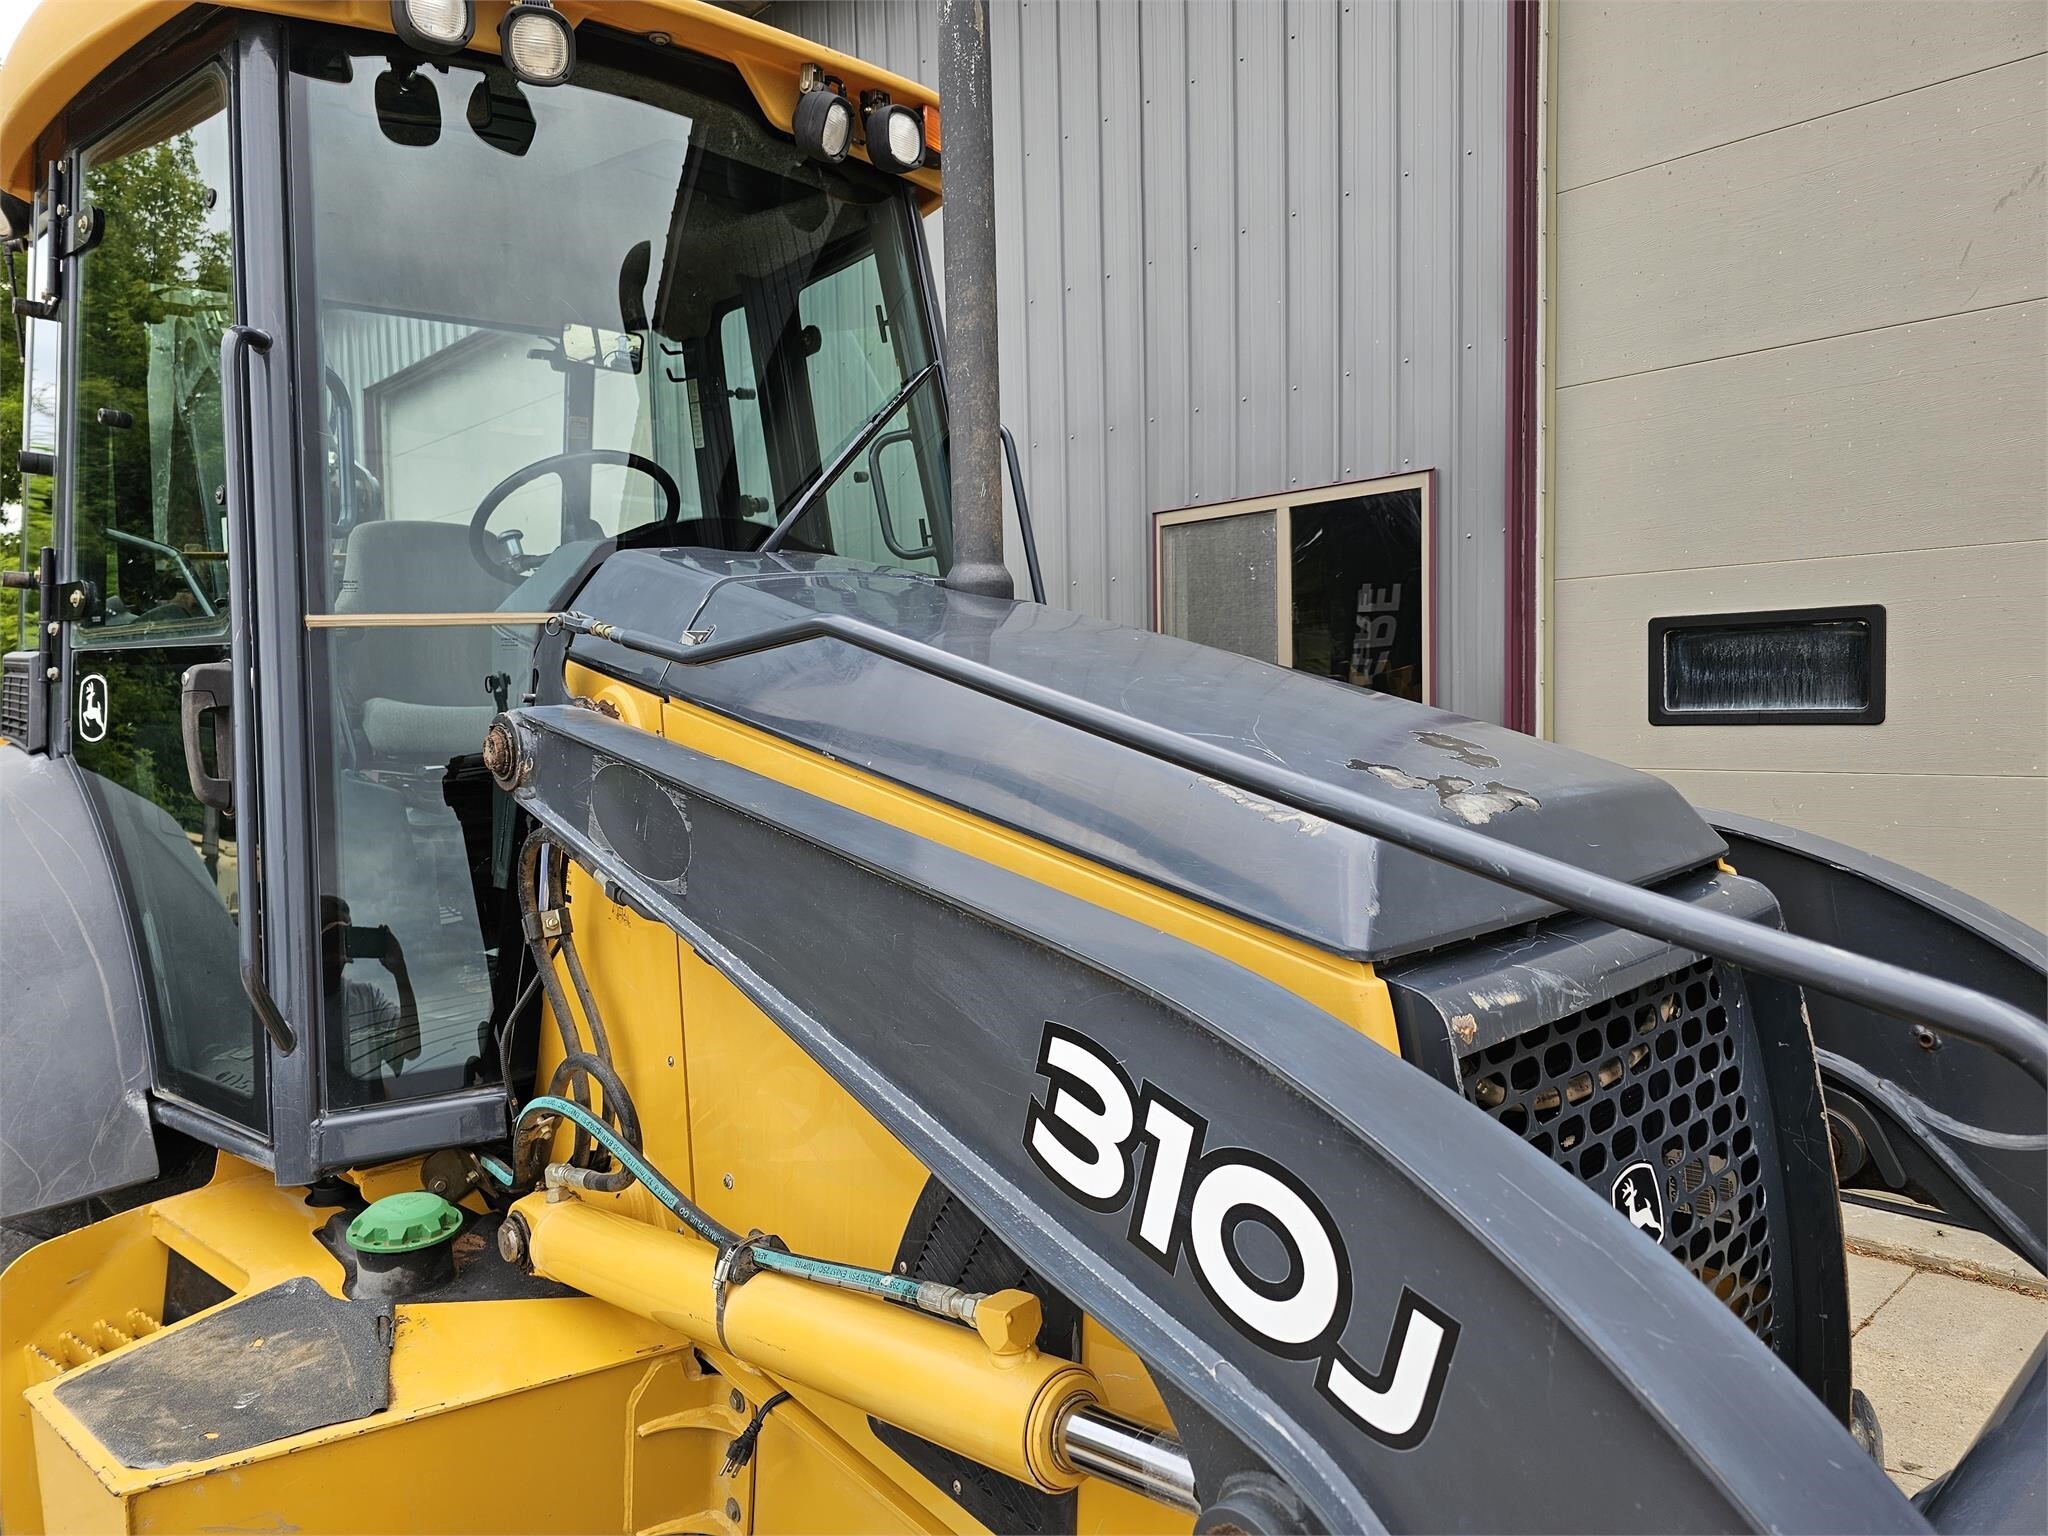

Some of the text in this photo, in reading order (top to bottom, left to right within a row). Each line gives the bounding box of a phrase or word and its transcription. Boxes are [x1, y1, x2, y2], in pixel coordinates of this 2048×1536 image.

[602, 1133, 614, 1147] BAR
[690, 1214, 705, 1231] PLUS
[1028, 1032, 1450, 1440] 310J
[889, 1280, 901, 1290] 295
